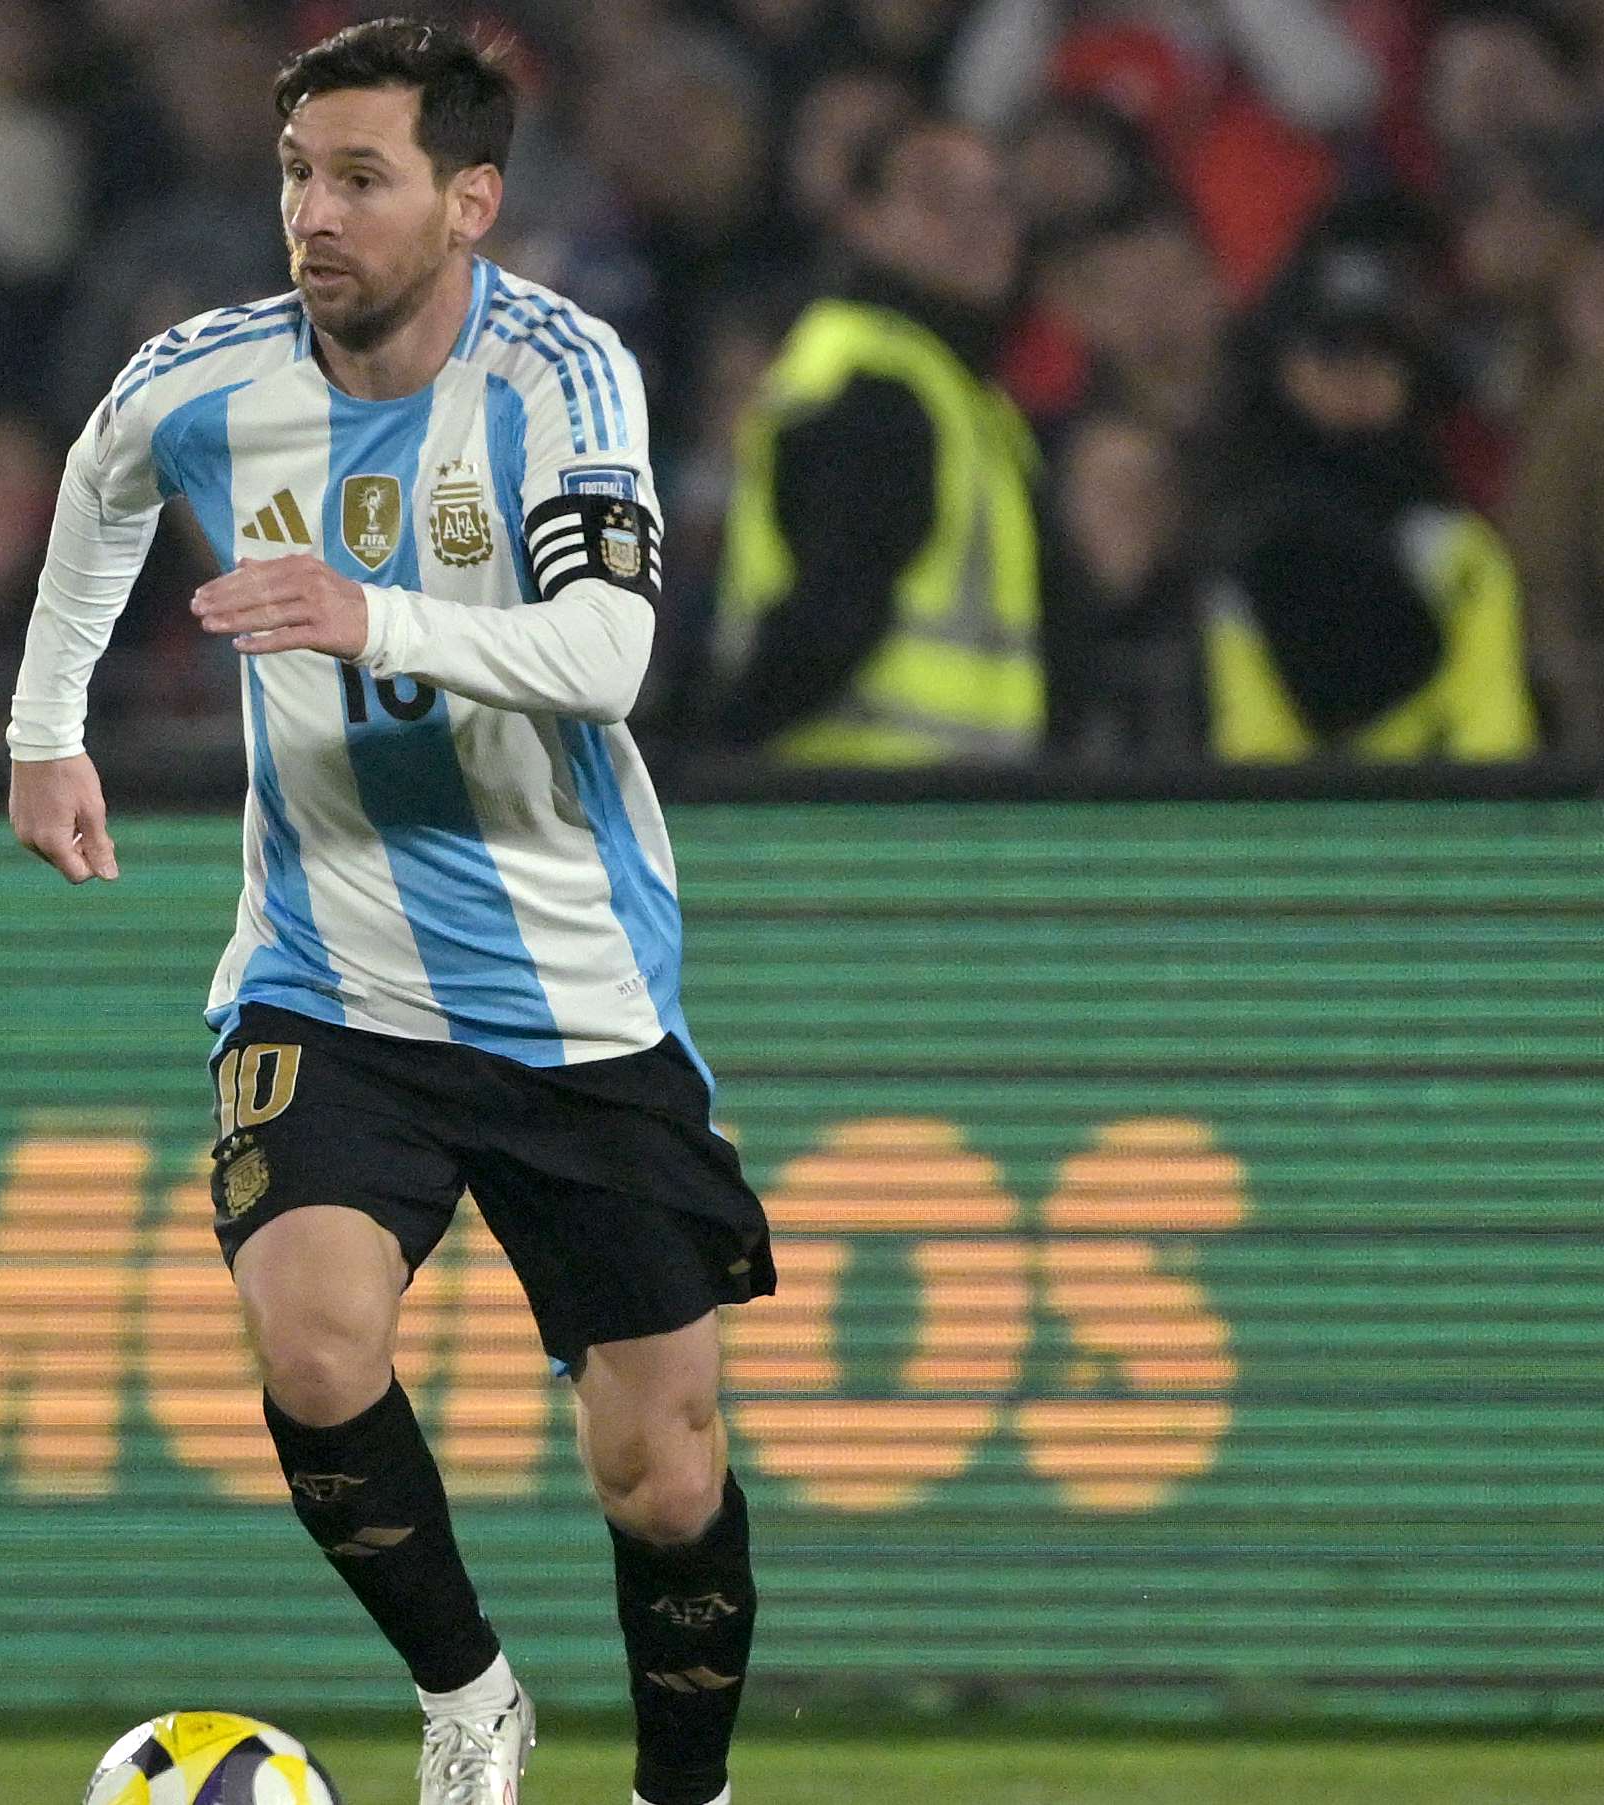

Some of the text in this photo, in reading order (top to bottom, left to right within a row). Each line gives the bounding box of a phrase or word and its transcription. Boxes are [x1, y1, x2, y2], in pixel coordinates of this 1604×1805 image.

[580, 482, 624, 498] FOOTBALL
[443, 504, 479, 544] AFA
[360, 534, 386, 546] FIFA
[218, 1042, 302, 1142] 10
